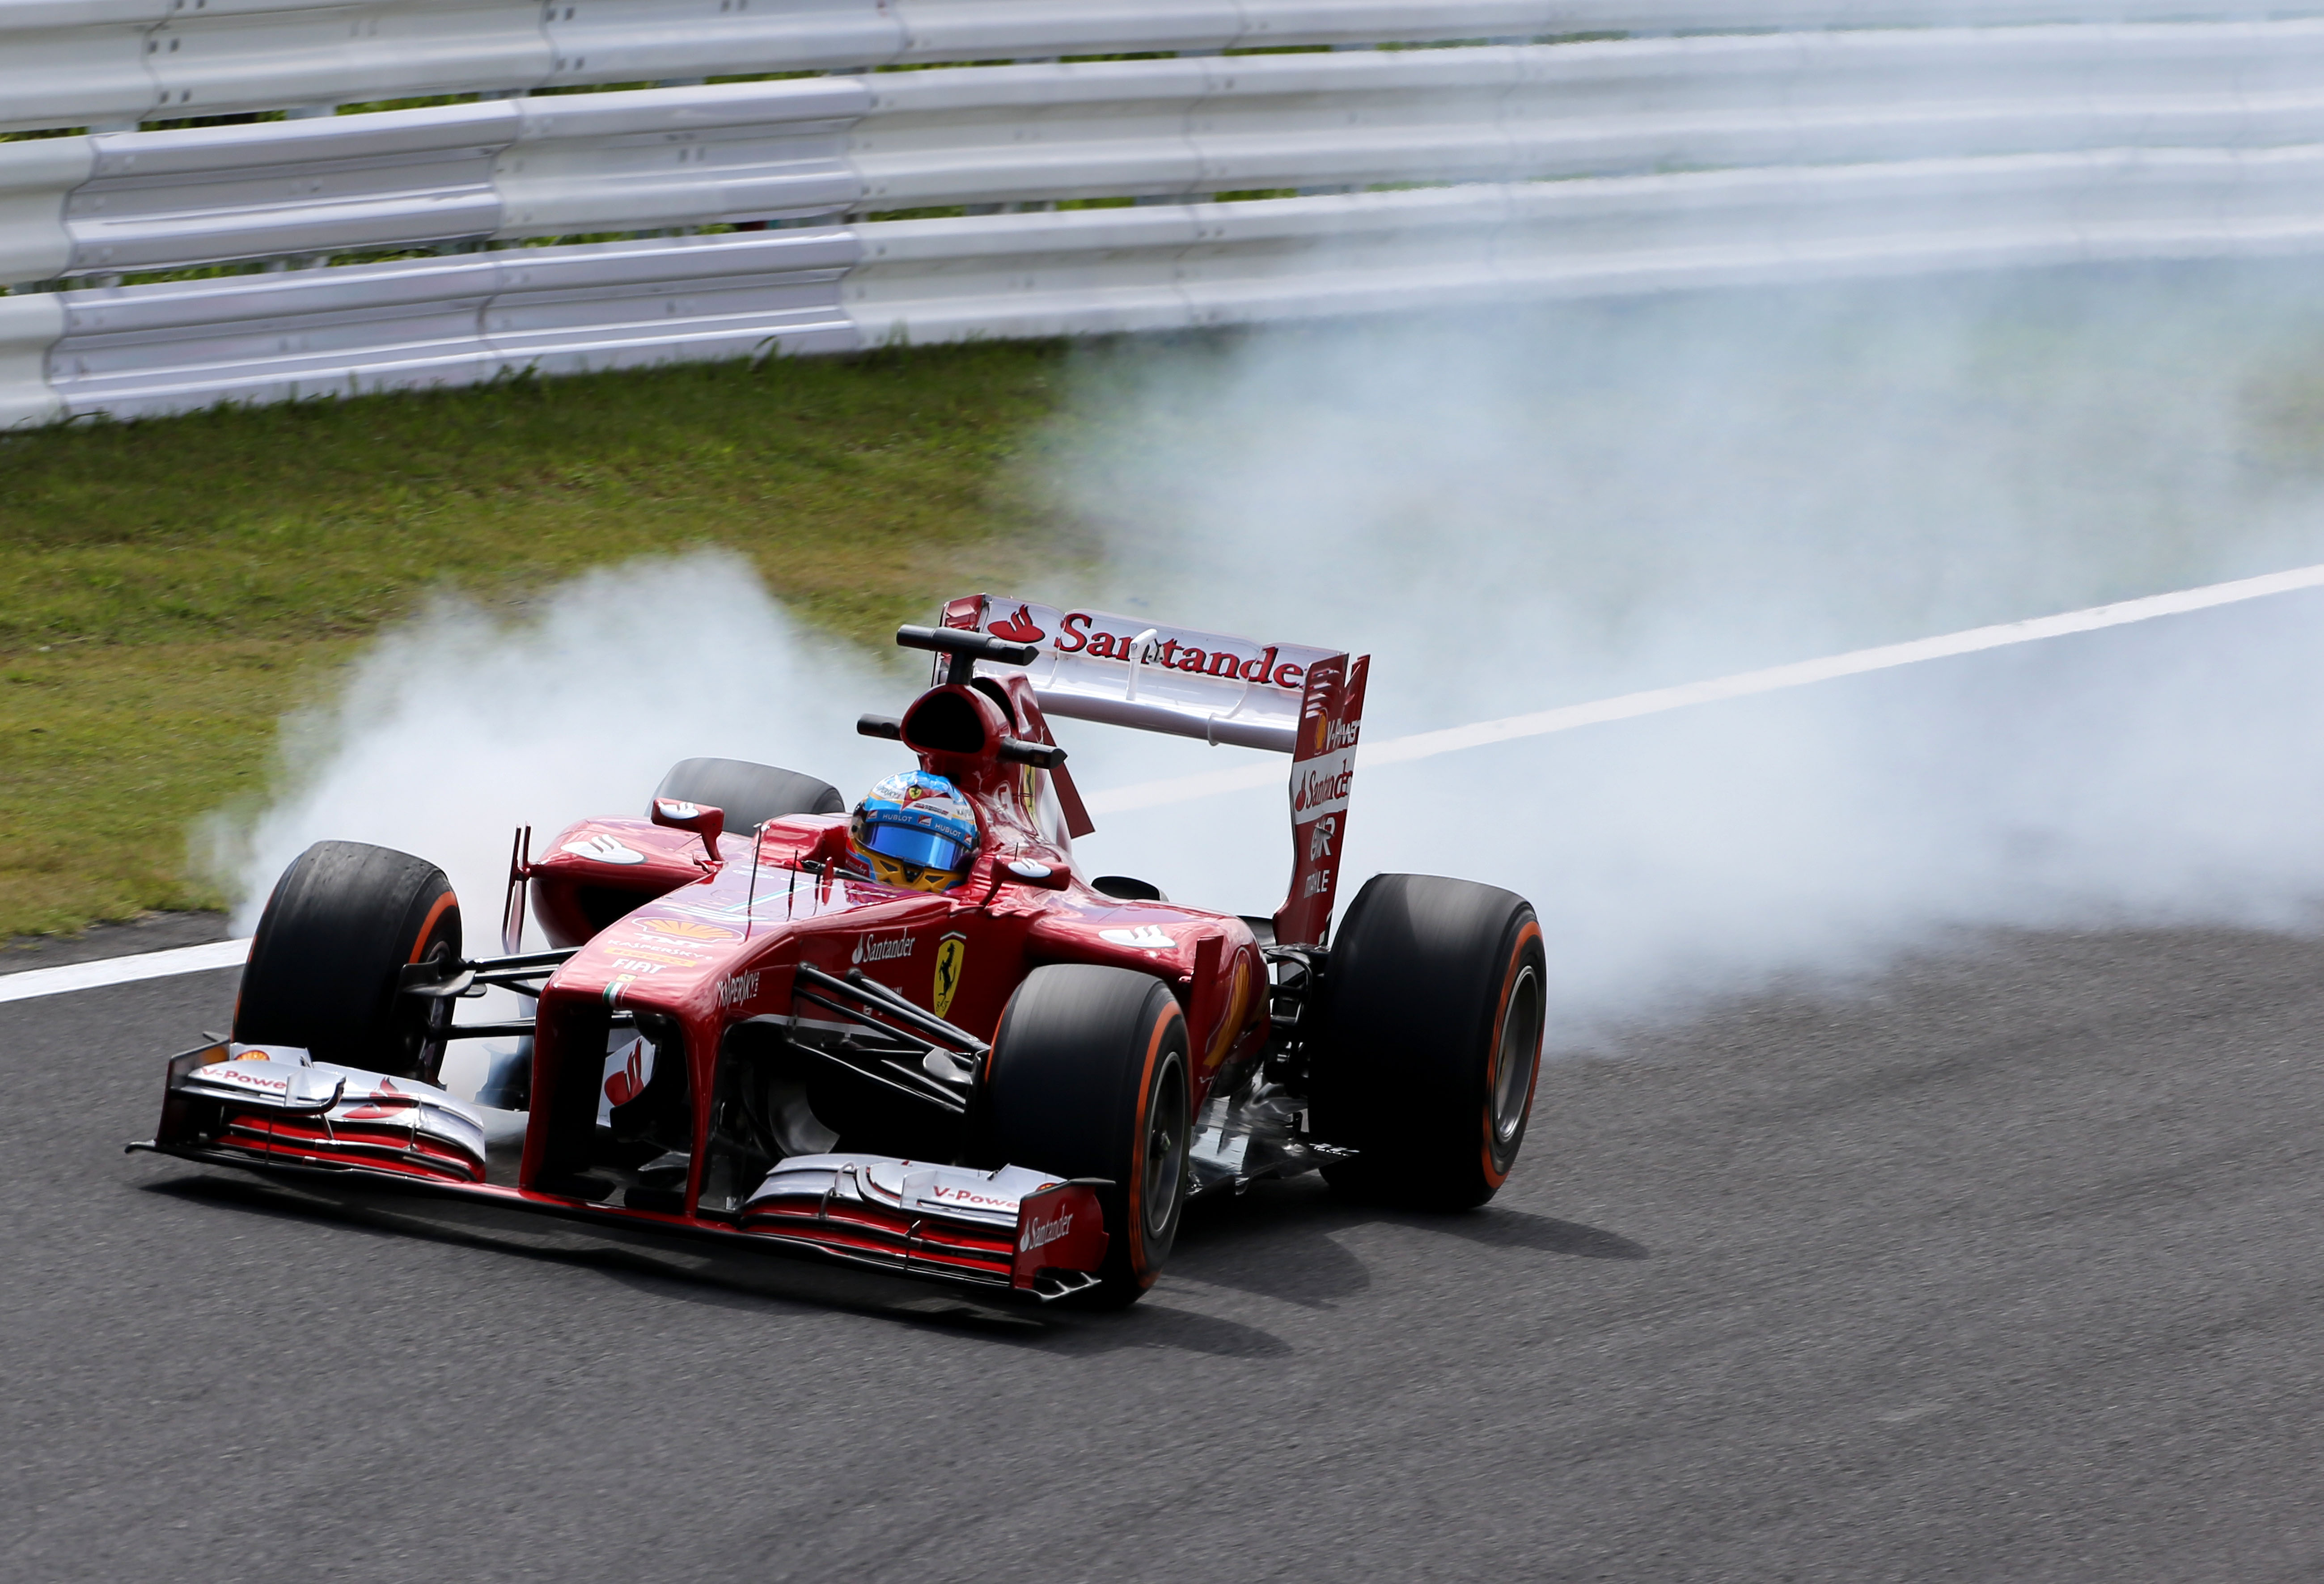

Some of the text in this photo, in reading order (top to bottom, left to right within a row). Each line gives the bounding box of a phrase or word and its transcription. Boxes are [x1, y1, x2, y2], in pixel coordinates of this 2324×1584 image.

[1054, 613, 1304, 689] Santande
[882, 813, 913, 822] HUBLOT
[935, 823, 961, 837] HUBLOT
[863, 926, 916, 963] Santander
[611, 958, 667, 974] FIAT
[201, 1067, 287, 1089] V-Powe
[933, 1185, 1020, 1208] V-Powe
[1029, 1203, 1073, 1250] Santander
